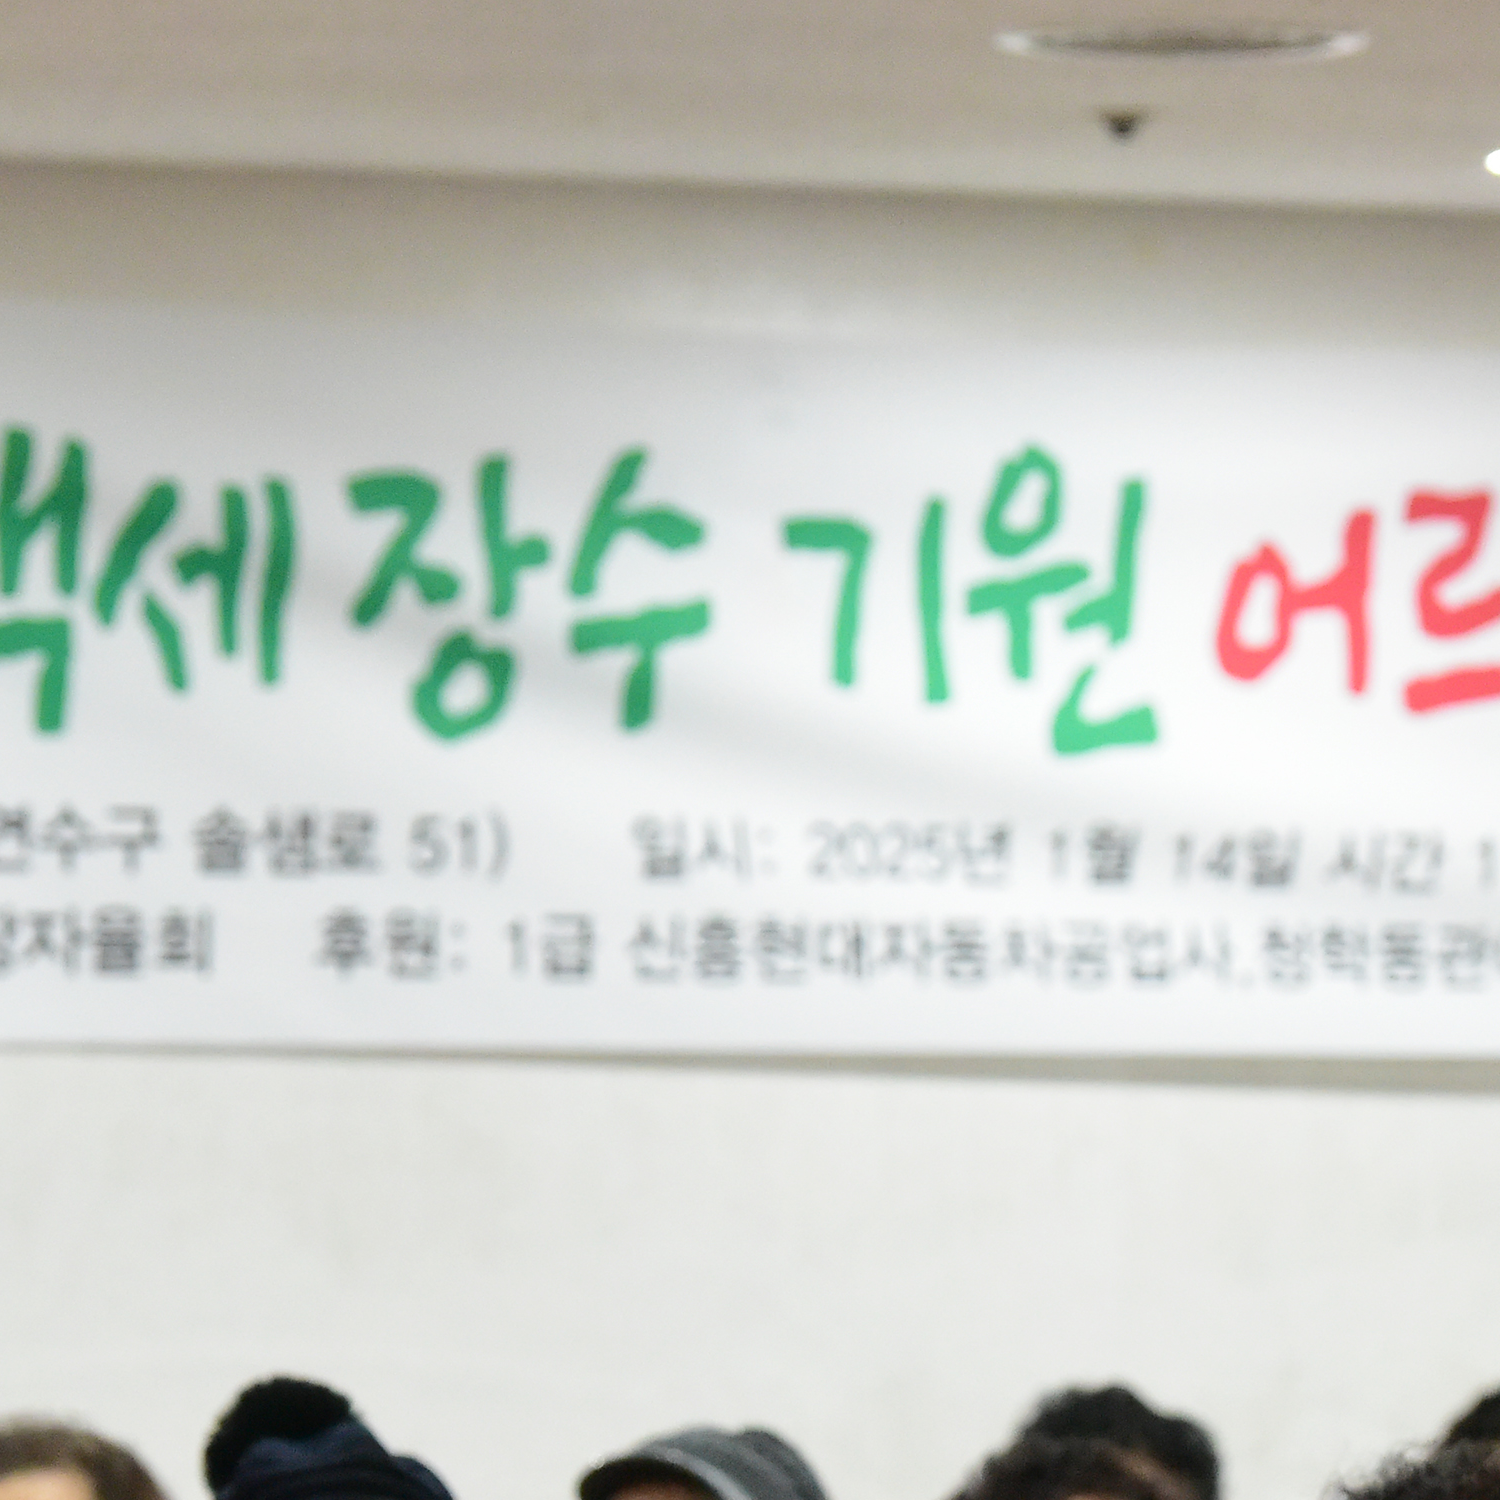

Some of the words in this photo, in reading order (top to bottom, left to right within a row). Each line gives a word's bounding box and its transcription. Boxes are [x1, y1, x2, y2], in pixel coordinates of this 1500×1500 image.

[346, 448, 710, 744] 장수
[781, 444, 1159, 756] 기원
[406, 806, 512, 882] 51)
[808, 816, 1014, 886] 2025년
[1047, 820, 1142, 889] 1월
[1171, 826, 1302, 891] 14일
[1324, 828, 1445, 896] 시간
